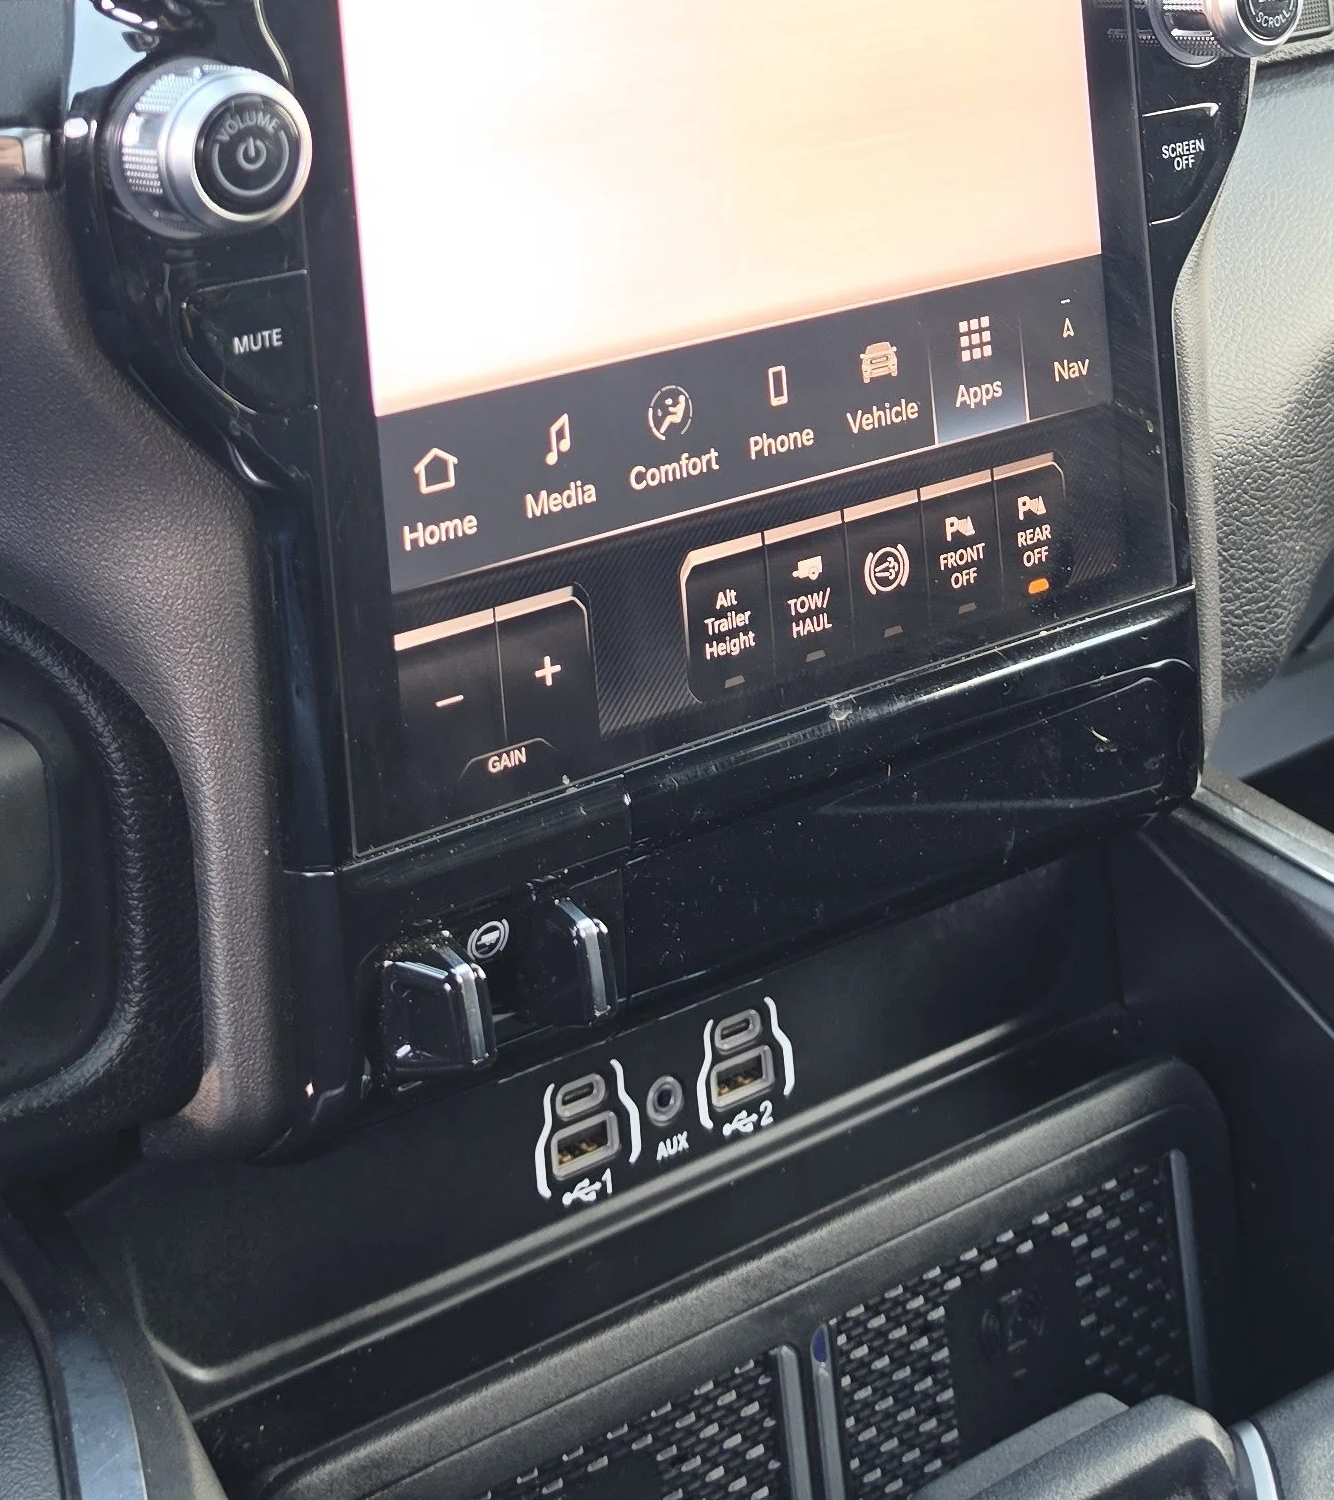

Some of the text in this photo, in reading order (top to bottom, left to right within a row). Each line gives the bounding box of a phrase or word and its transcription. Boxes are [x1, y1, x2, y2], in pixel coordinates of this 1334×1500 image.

[1255, 9, 1292, 29] SCROLL
[217, 110, 281, 143] VOLUME
[1161, 138, 1205, 159] SCREEN
[1173, 156, 1196, 172] OFF
[232, 329, 284, 354] MUTE
[1053, 356, 1091, 382] Nav
[954, 376, 1003, 408] Apps
[846, 398, 919, 435] Vehicle
[748, 424, 815, 460] Phone
[628, 448, 720, 491] Comfort
[524, 479, 598, 519] Media
[402, 513, 479, 552] Home
[1017, 523, 1052, 548] REAR
[938, 542, 986, 571] FRONT
[1023, 545, 1049, 567] OFF
[950, 567, 978, 589] OFF
[715, 588, 738, 610] Alt
[786, 586, 831, 617] TOW/
[703, 610, 752, 636] Trailer
[791, 612, 833, 639] HAUL
[704, 630, 756, 660] Height
[487, 746, 527, 775] GAIN
[656, 1130, 690, 1160] AUX
